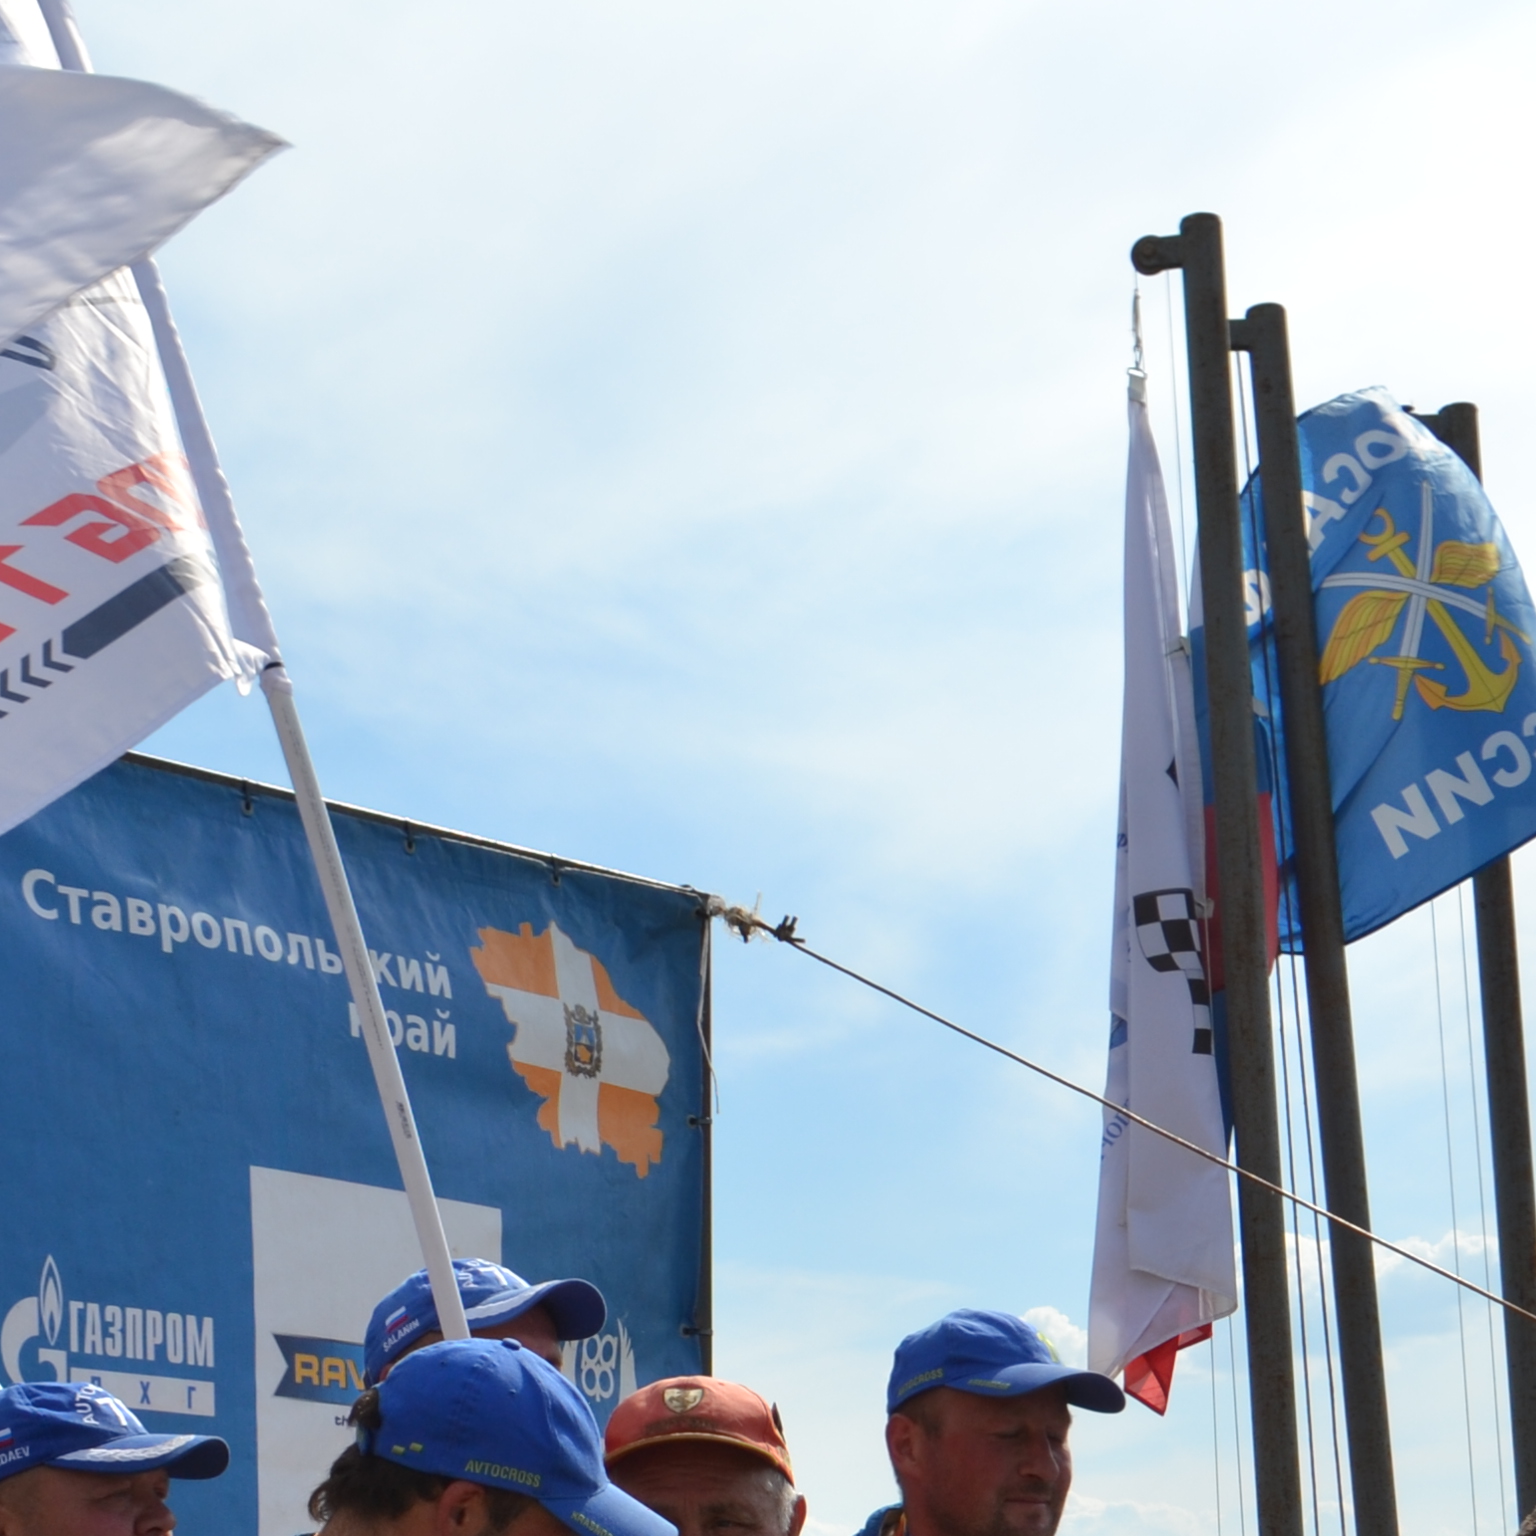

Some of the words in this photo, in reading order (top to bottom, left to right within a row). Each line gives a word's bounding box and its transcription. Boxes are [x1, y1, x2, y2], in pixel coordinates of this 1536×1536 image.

[21, 867, 453, 1000] Ставрополький
[69, 1300, 215, 1369] ГАЗПРОМ
[383, 1318, 421, 1353] SALANIN
[464, 1459, 542, 1488] AVTOCROSS
